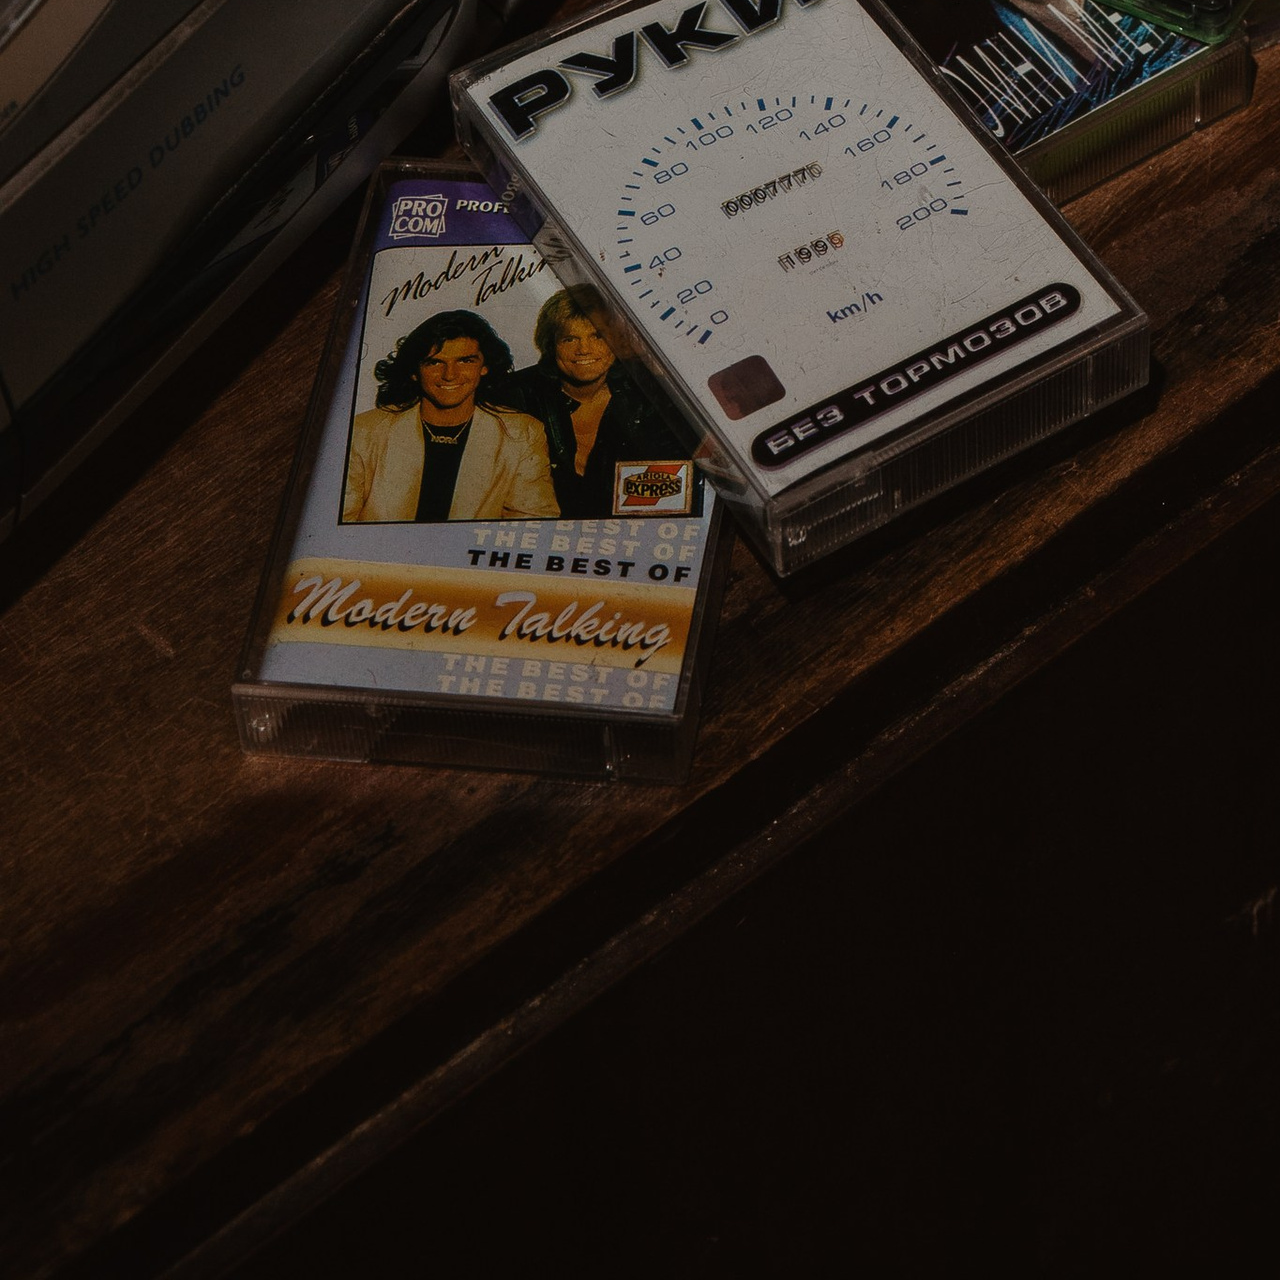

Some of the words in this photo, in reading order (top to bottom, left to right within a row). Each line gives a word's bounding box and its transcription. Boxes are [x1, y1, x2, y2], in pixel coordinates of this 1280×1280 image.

[746, 108, 794, 135] 120
[799, 114, 847, 141] 140
[686, 125, 734, 152] 100
[844, 129, 892, 158] 160
[10, 240, 72, 301] HIGH
[76, 165, 145, 237] SPEED
[147, 62, 248, 171] DUBBING
[653, 162, 689, 185] 80
[881, 162, 929, 191] 180
[398, 199, 443, 218] PRO
[640, 203, 676, 226] 60
[896, 198, 948, 231] 200
[399, 216, 440, 235] COM
[648, 246, 682, 271] 40
[777, 229, 845, 273] 1999
[381, 245, 505, 317] Modern
[471, 249, 552, 308] Talkin
[676, 279, 713, 305] 20
[709, 309, 729, 326] 0
[826, 290, 883, 325] km/h
[764, 406, 846, 457] БЕЗ
[852, 288, 1070, 407] ТОРМОЗОВ
[635, 471, 673, 482] ARIOLA
[472, 528, 538, 551] THE
[550, 537, 641, 558] BEST
[653, 543, 697, 563] OF
[467, 549, 534, 570] THE
[545, 555, 636, 578] BEST
[647, 563, 692, 583] OF
[287, 575, 479, 637] Modern
[496, 591, 673, 669] Talking
[442, 653, 511, 676] THE
[521, 659, 610, 685] BEST
[626, 669, 674, 691] OF
[437, 674, 508, 697] THE
[515, 680, 610, 705] BEST
